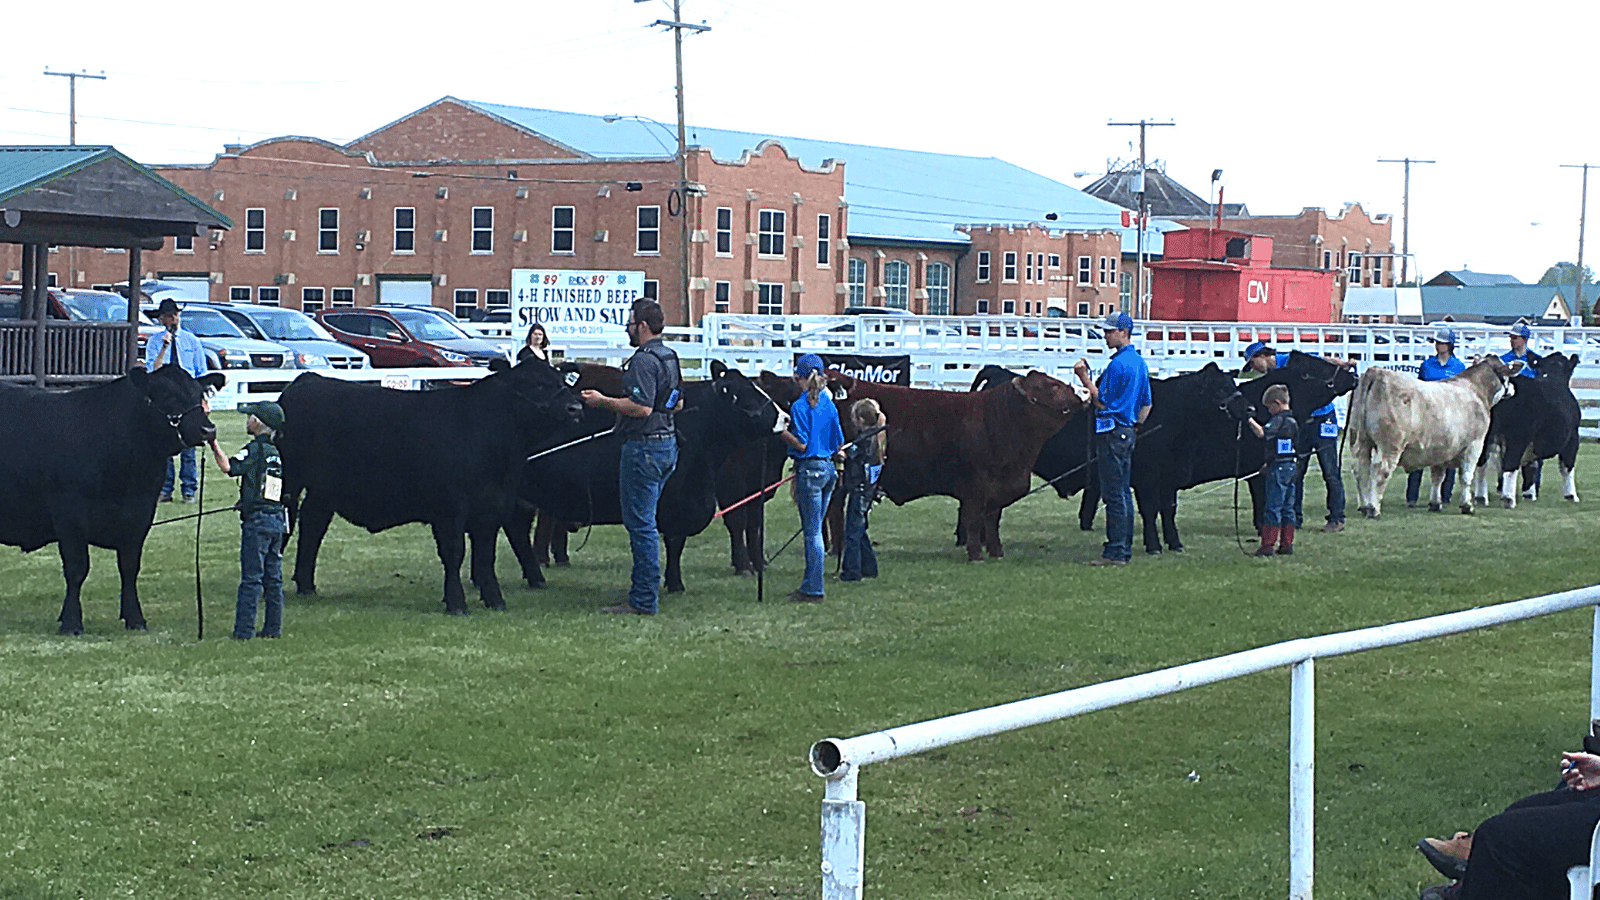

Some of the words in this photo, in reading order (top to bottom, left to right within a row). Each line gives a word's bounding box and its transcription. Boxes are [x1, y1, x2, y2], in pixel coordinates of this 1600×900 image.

[518, 288, 538, 302] 4-H
[543, 288, 601, 303] FINISHED
[607, 289, 638, 304] BEEF
[1248, 280, 1269, 303] CN
[518, 306, 561, 327] SHOW
[564, 307, 596, 322] AND
[551, 325, 569, 334] JUNE
[570, 325, 587, 334] 9-10
[1390, 364, 1421, 374] LIVESTO
